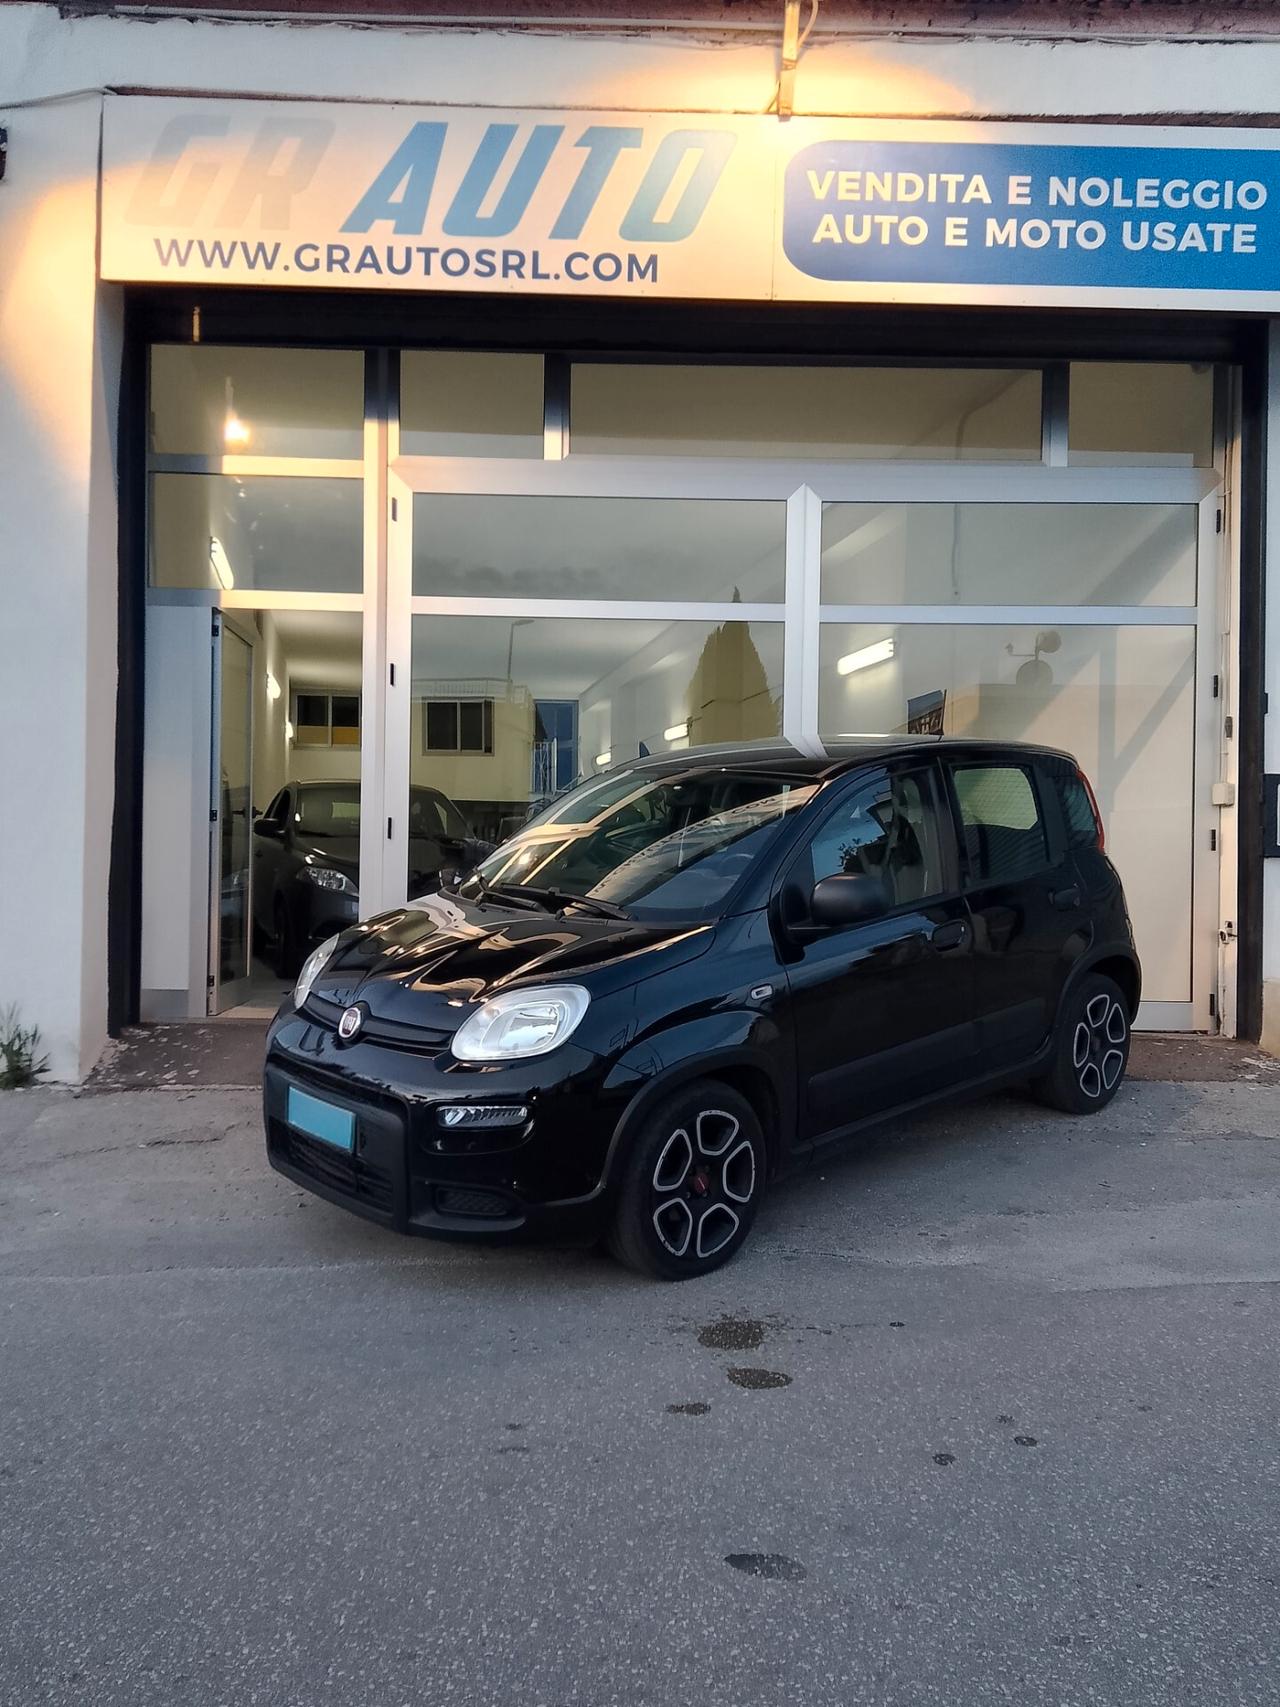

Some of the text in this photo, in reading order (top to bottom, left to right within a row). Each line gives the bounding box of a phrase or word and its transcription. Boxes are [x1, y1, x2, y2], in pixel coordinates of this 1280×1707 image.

[124, 114, 737, 243] GR AUTO
[807, 169, 1268, 211] VENDITA E NOLEGGIO
[812, 214, 1257, 253] AUTO E MOTO USATE
[153, 238, 659, 284] WWW.GRAUTOSRL.COM
